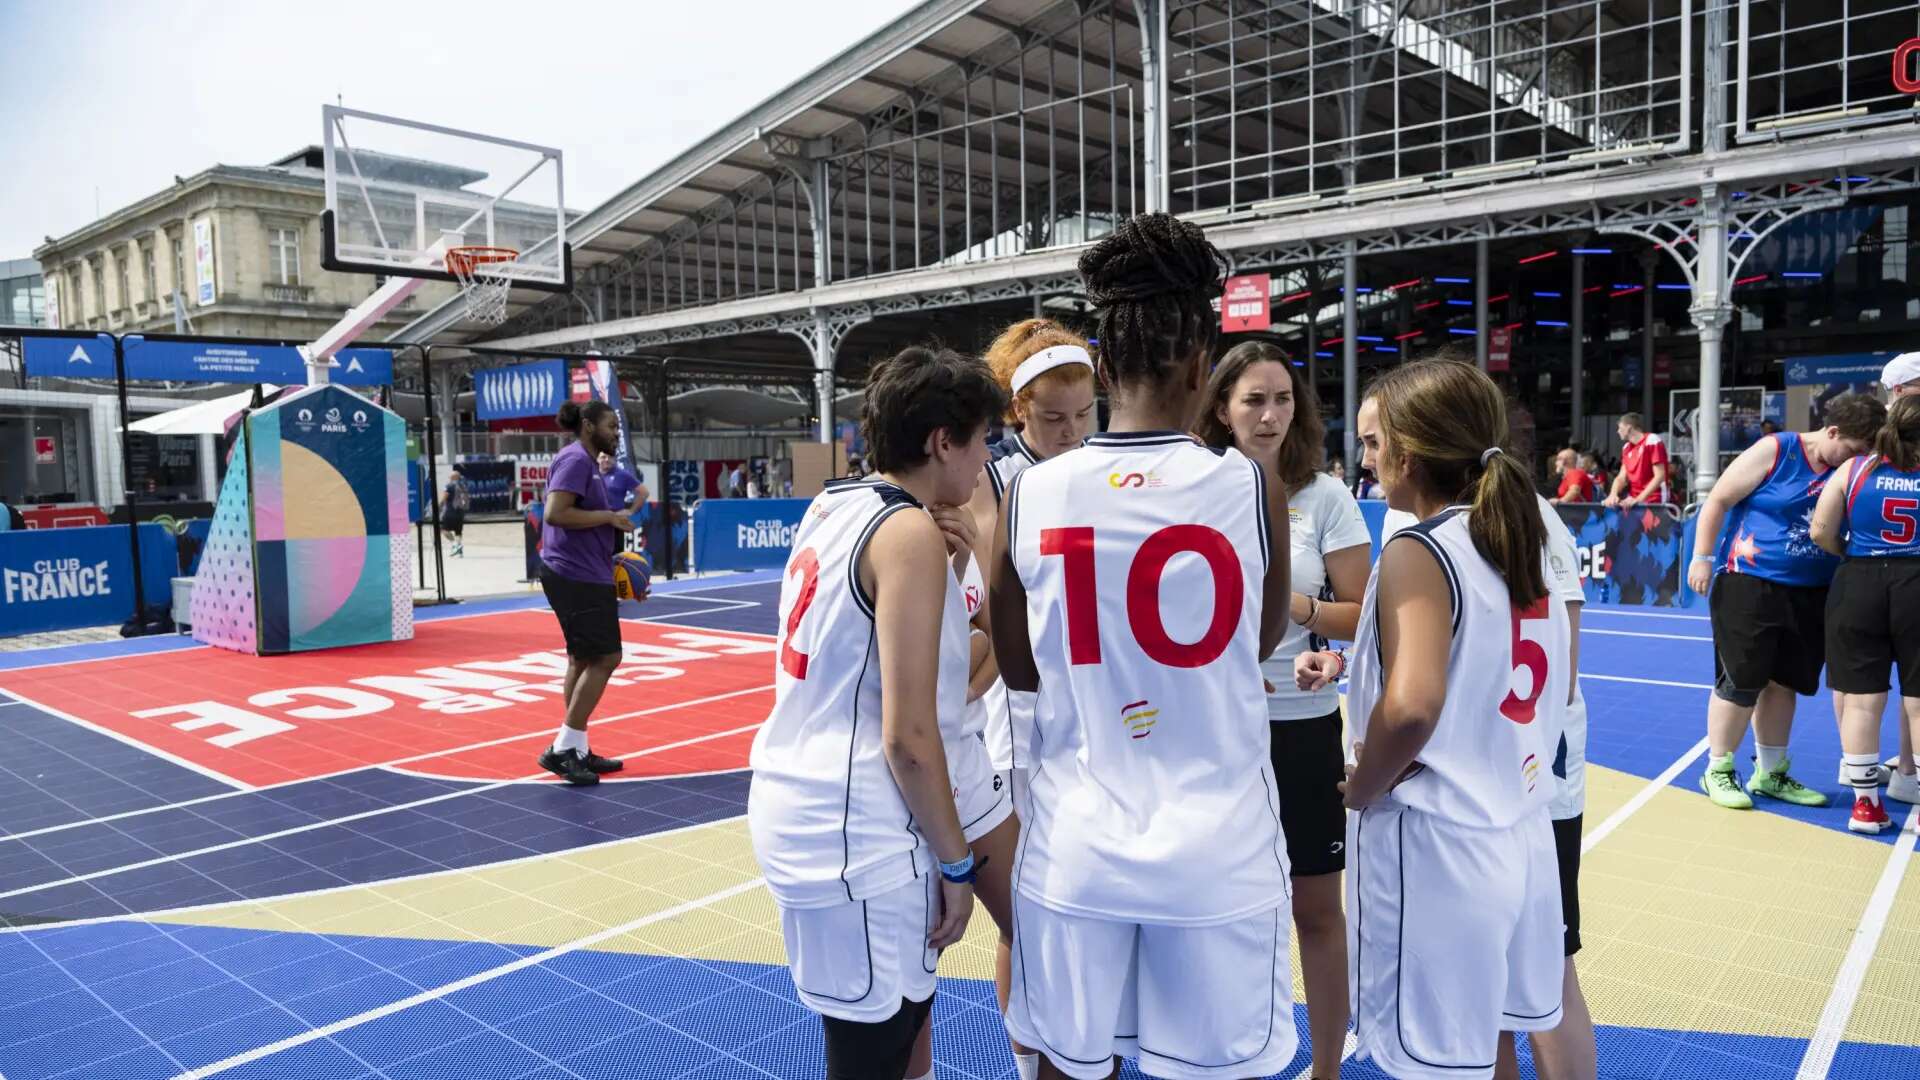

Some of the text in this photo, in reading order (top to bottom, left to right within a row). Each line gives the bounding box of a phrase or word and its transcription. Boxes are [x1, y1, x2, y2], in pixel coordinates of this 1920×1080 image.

[321, 424, 348, 433] PARIS
[755, 520, 783, 530] CLUB
[1880, 496, 1919, 545] 5
[4, 560, 111, 604] FRANCE
[34, 558, 81, 574] CLUB
[781, 546, 820, 681] 2
[1040, 523, 1244, 668] 10
[1499, 595, 1549, 724] 5
